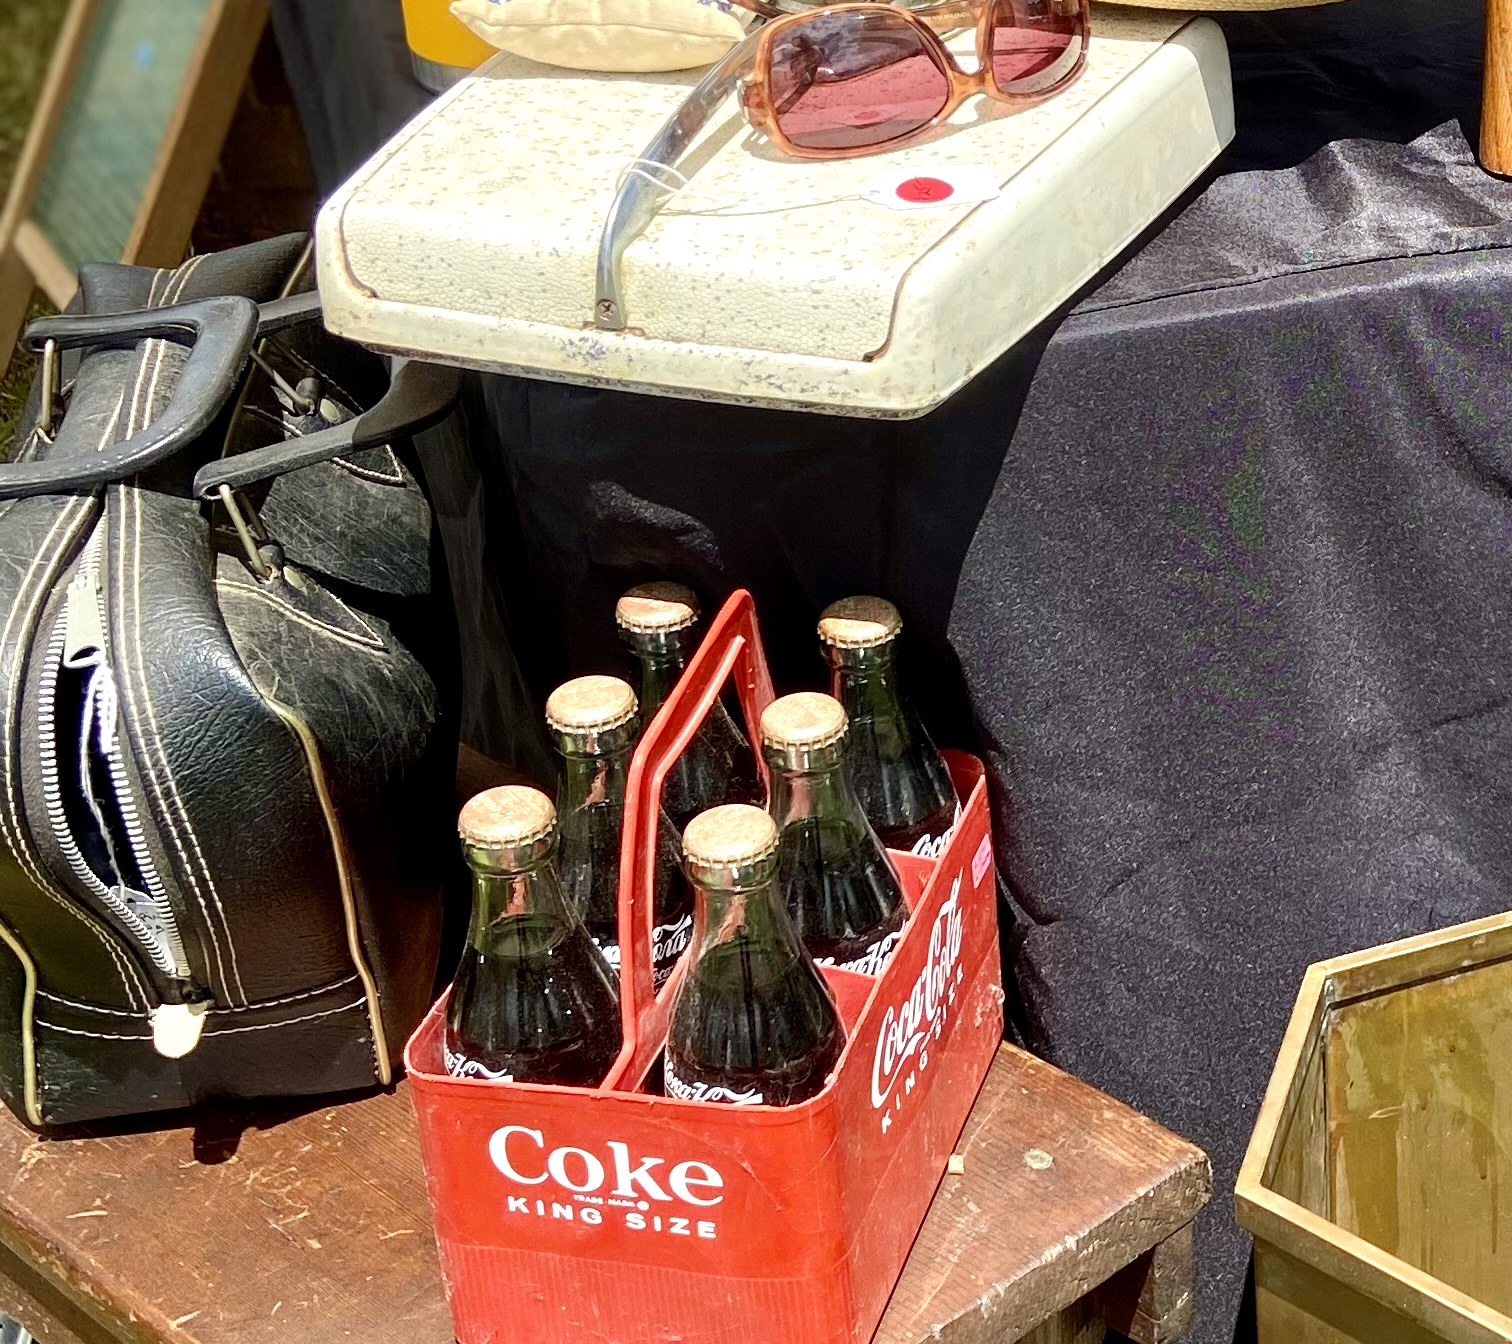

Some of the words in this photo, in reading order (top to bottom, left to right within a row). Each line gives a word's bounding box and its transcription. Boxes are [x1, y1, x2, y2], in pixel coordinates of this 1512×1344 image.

[871, 866, 964, 1109] Coca-Cola
[881, 1049, 928, 1135] KING
[488, 1125, 724, 1206] Coke
[507, 1195, 603, 1225] KING
[625, 1212, 717, 1239] SIZE
